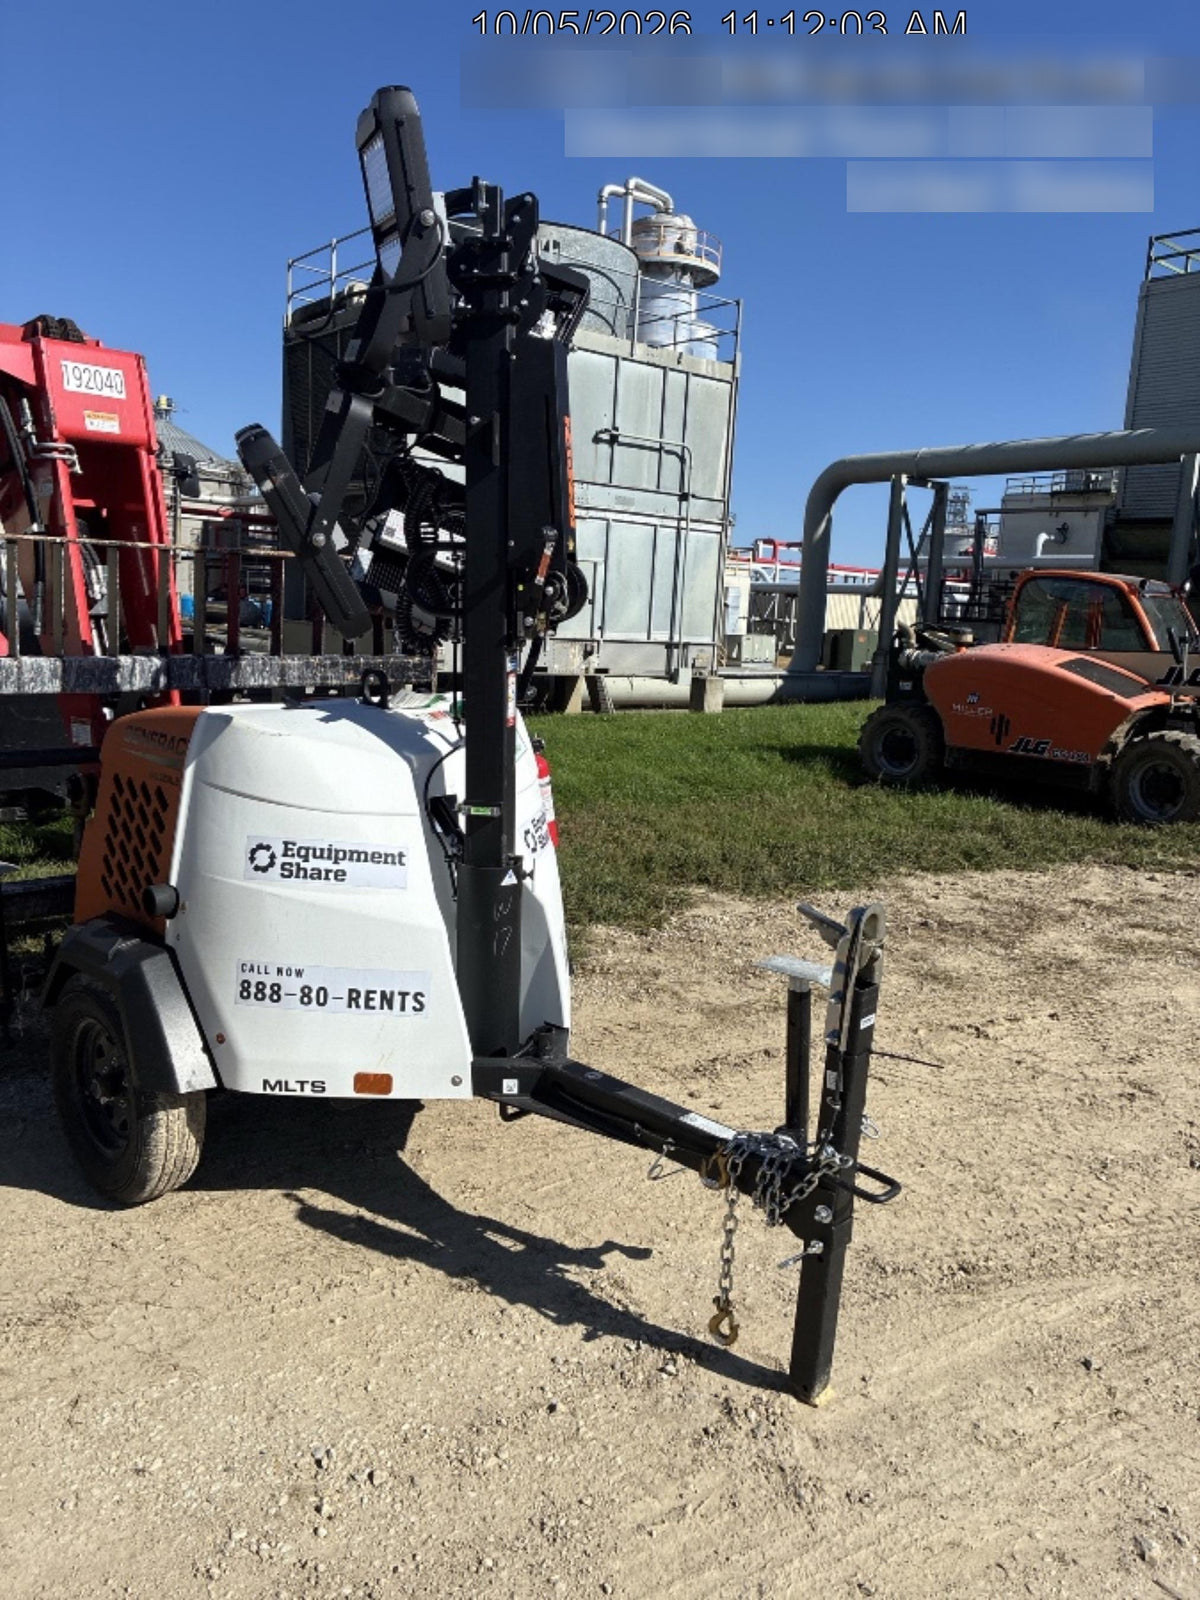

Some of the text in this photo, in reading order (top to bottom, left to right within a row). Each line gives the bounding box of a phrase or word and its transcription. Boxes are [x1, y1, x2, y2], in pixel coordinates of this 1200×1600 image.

[60, 364, 124, 395] 192040
[1007, 735, 1053, 757] JLG
[281, 840, 407, 867] Equipment
[280, 862, 347, 883] Share
[241, 962, 305, 979] CALL NOW
[239, 979, 427, 1013] 888-80-RENTS
[262, 1078, 327, 1094] MLTS
